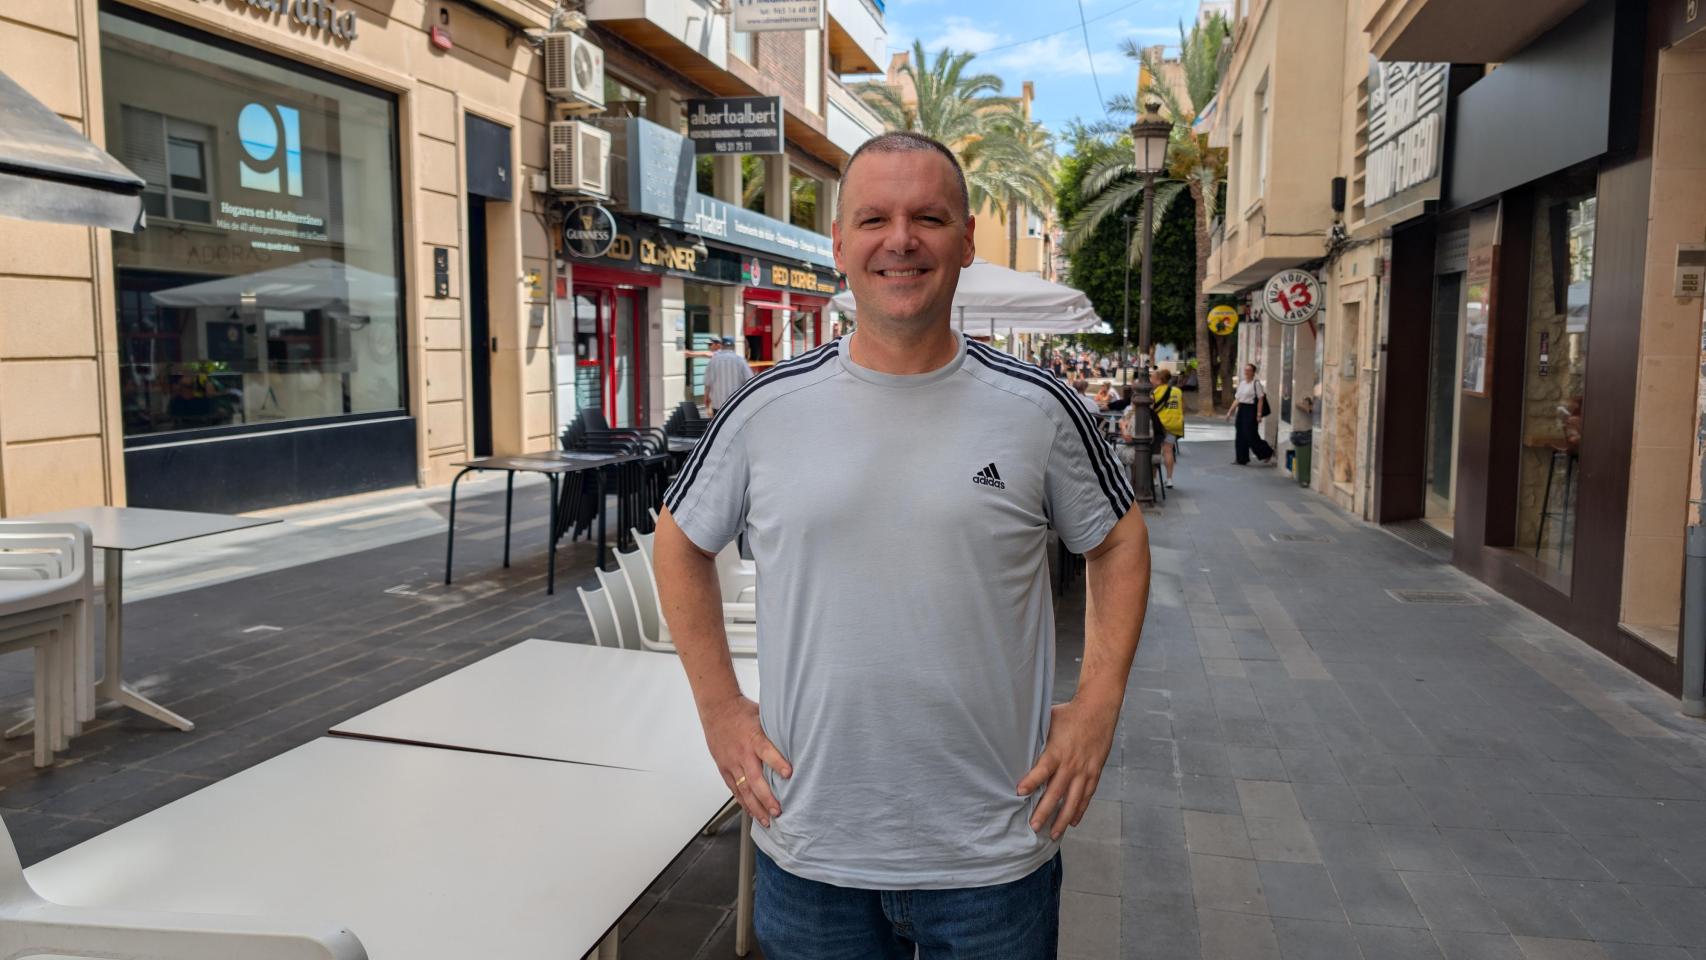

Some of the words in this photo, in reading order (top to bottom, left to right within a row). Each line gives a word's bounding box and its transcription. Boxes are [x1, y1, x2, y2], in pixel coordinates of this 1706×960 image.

[690, 102, 776, 125] albertoalbert
[221, 202, 255, 217] Hogares
[566, 228, 609, 241] GUINNESS
[772, 265, 789, 286] RED
[790, 269, 818, 291] CORNER
[1281, 273, 1314, 288] HOUSE
[1277, 283, 1313, 313] 13
[1284, 302, 1315, 319] LAGER
[972, 476, 1005, 490] adidas
